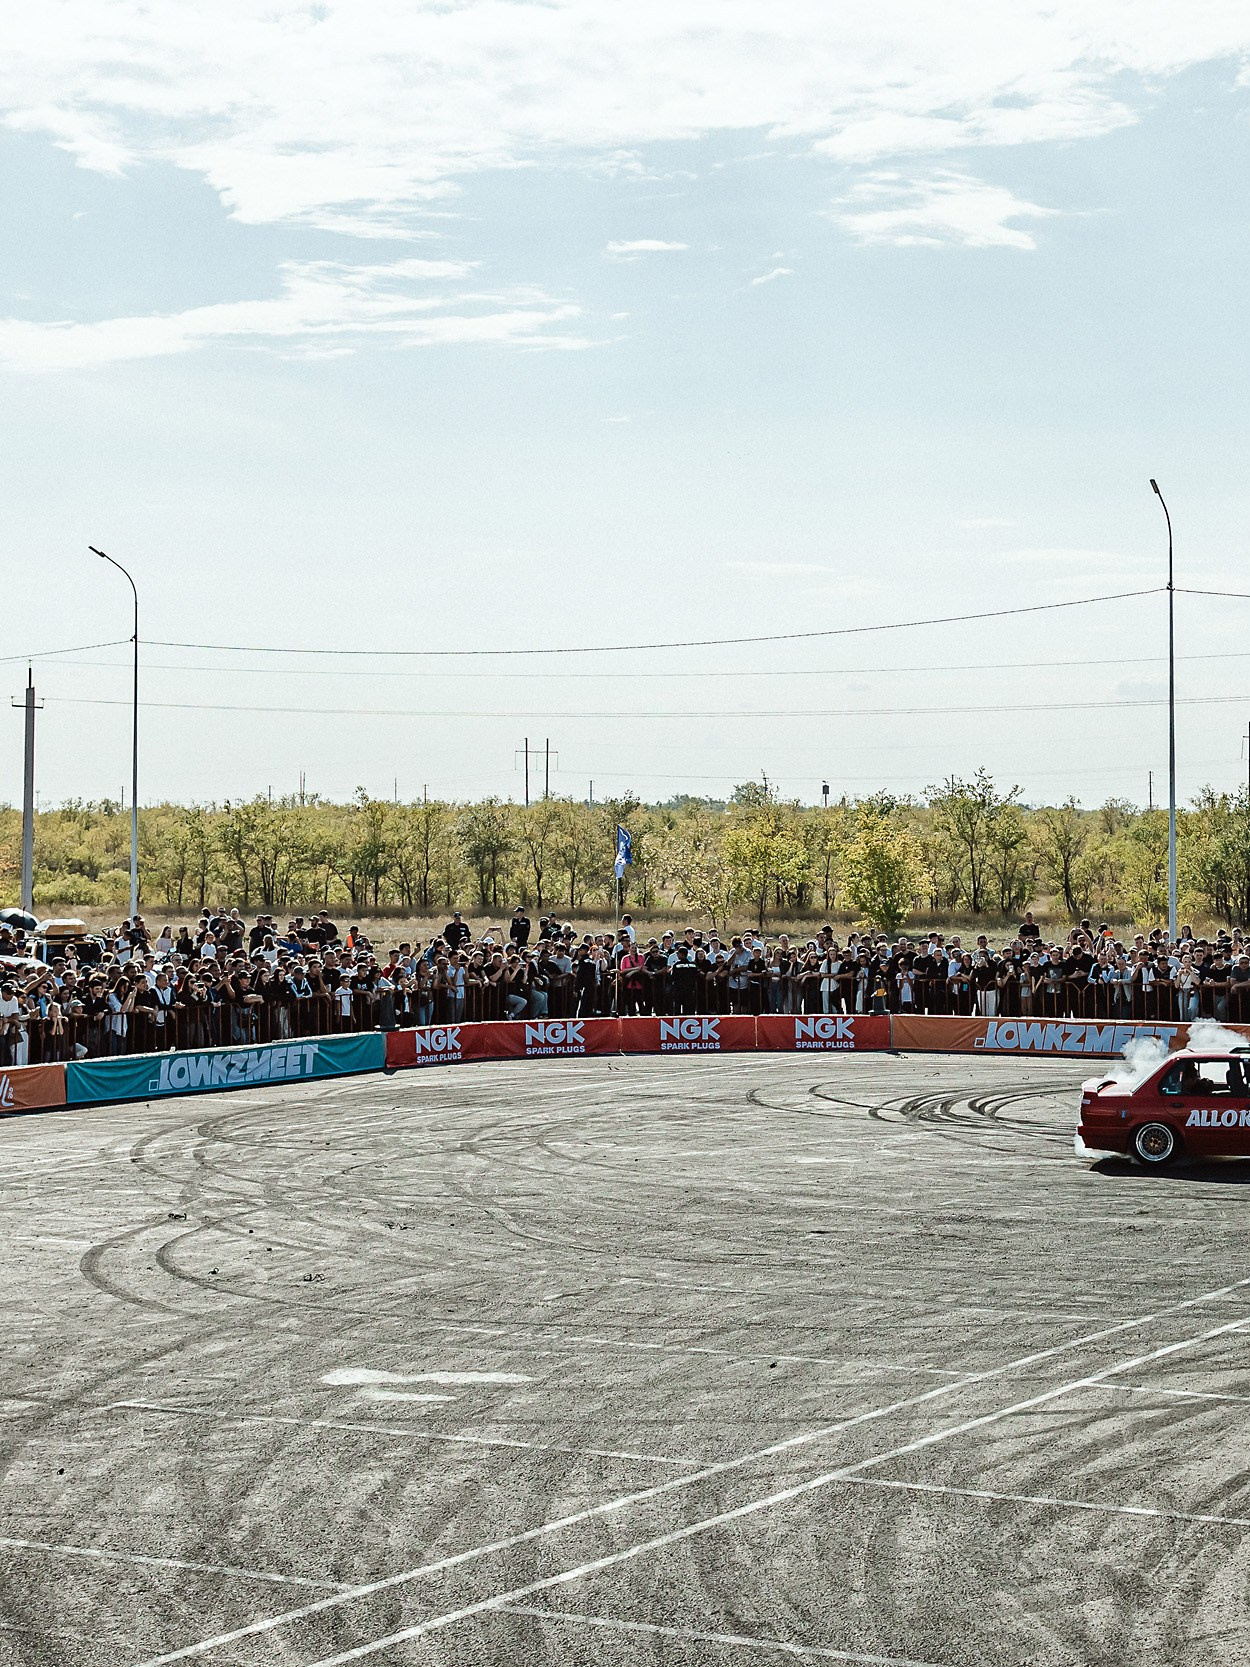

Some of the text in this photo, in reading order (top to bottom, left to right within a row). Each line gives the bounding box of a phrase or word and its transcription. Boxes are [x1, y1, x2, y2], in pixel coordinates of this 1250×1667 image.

[525, 1020, 586, 1046] NGK
[660, 1017, 721, 1041] NGK
[795, 1017, 855, 1040] NGK
[415, 1026, 462, 1054] NGK
[660, 1042, 721, 1050] SPARK PLUGS
[795, 1041, 855, 1049] SPARK PLUGS
[416, 1051, 462, 1064] SPARK PLUGS
[526, 1045, 586, 1055] SPARK PLUGS
